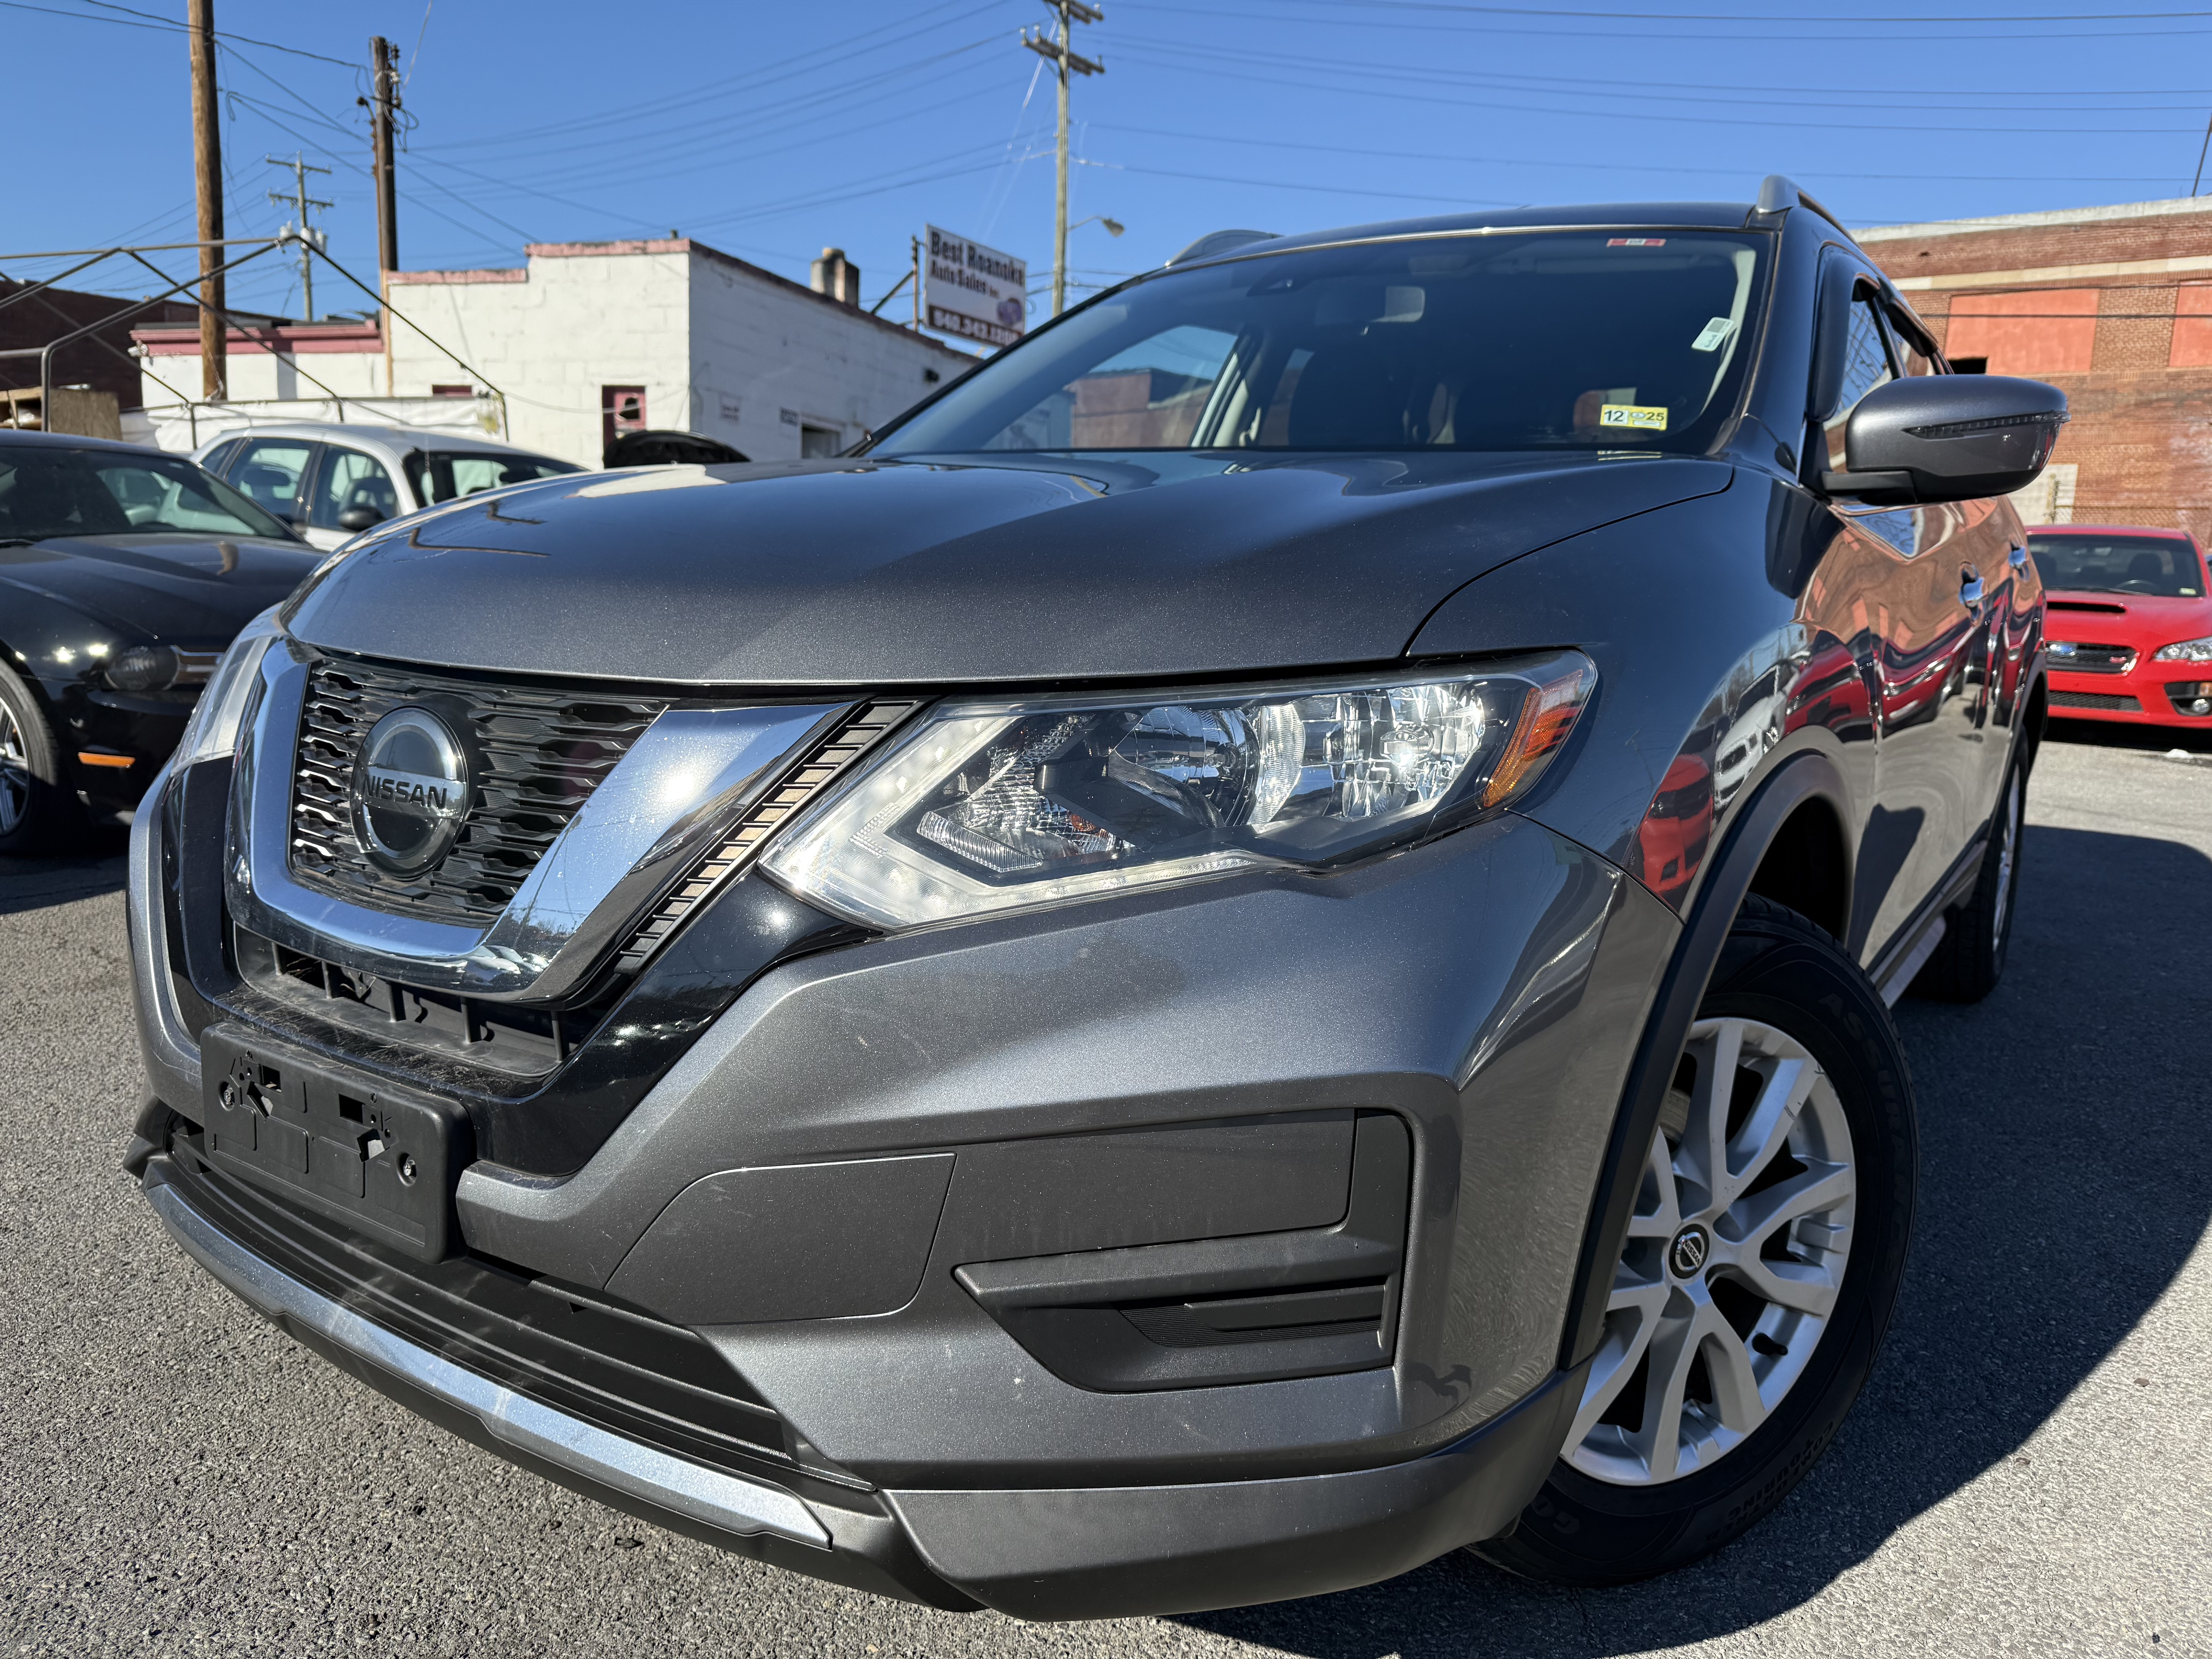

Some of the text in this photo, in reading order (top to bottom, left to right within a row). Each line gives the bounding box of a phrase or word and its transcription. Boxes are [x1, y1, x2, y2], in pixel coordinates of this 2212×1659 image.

[931, 231, 1023, 286] Best Roanoke
[931, 259, 955, 285] Auto
[958, 268, 986, 295] Sales
[1604, 410, 1664, 422] 12 25
[362, 775, 448, 810] NISSAN
[1684, 1240, 1701, 1265] NISSAN
[1728, 1438, 1814, 1520] TOURING
